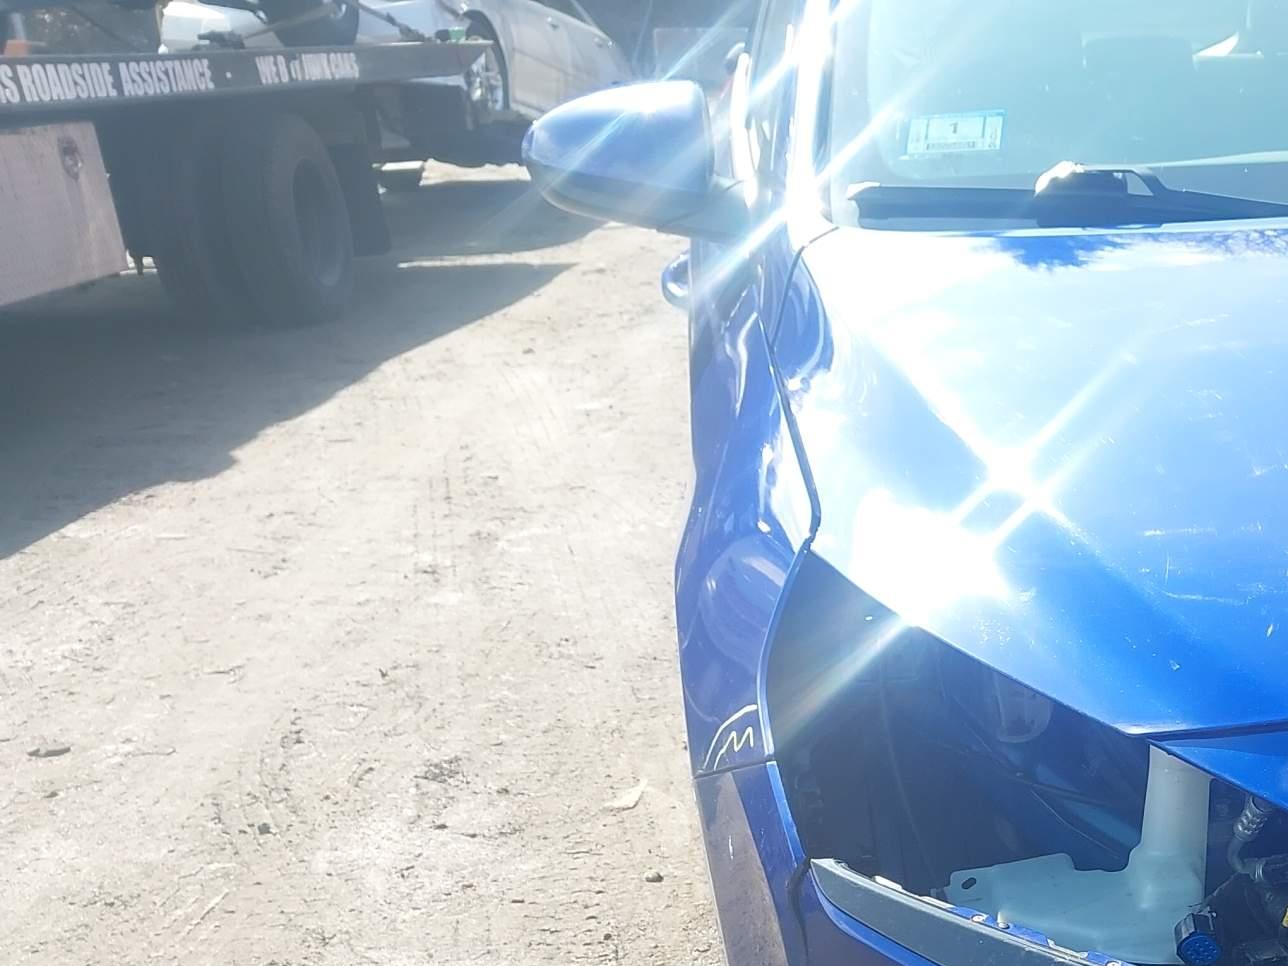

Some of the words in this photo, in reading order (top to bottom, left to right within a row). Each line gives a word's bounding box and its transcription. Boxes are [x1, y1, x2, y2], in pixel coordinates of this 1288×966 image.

[0, 64, 20, 103] S
[16, 62, 118, 102] ROADSIDE
[118, 58, 214, 96] ASSISTANCE
[255, 55, 280, 85] WE
